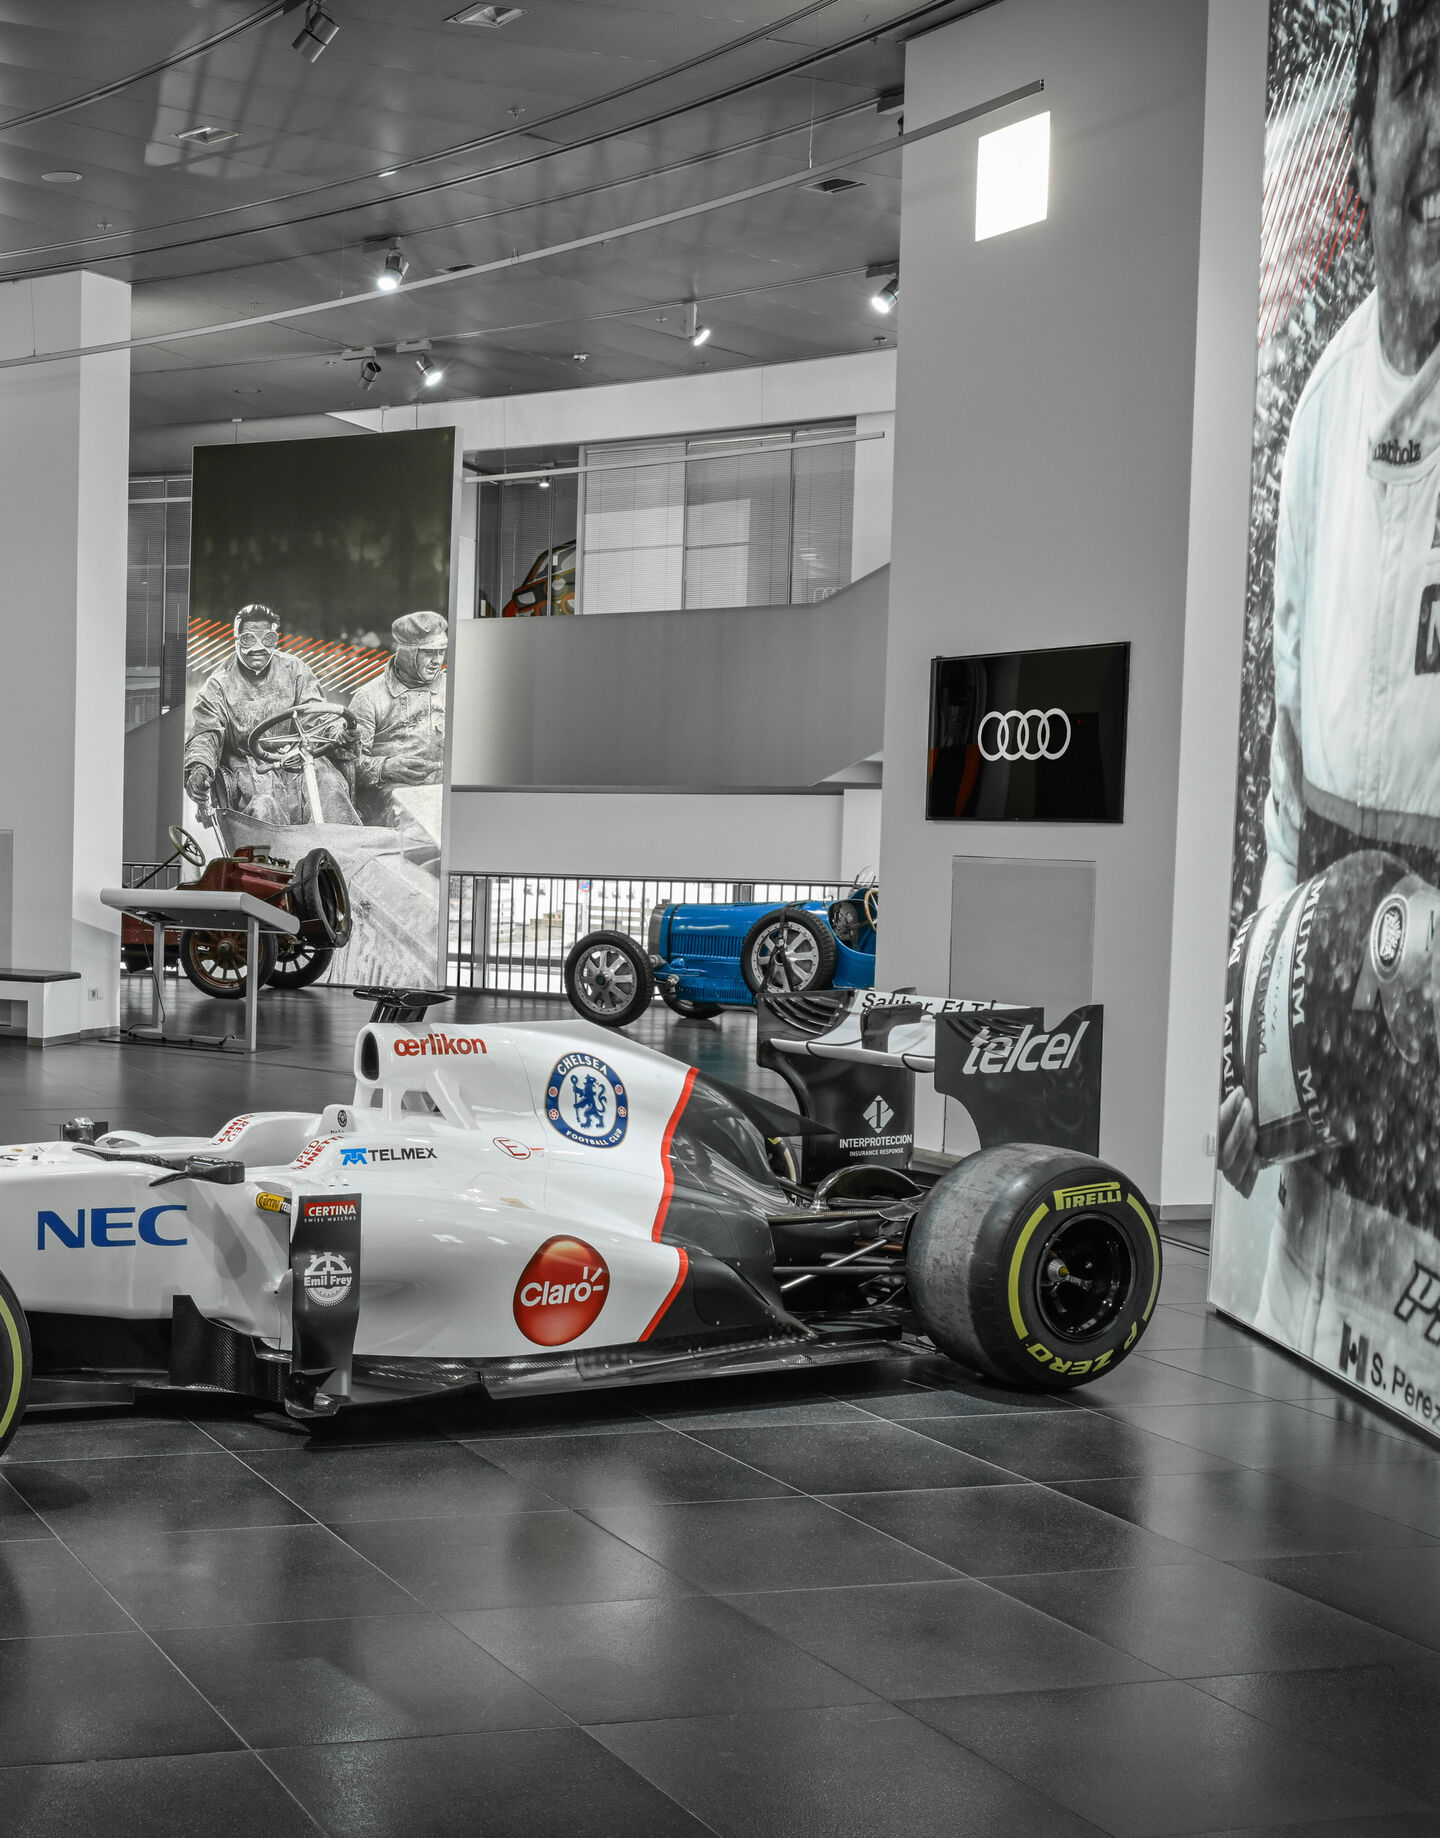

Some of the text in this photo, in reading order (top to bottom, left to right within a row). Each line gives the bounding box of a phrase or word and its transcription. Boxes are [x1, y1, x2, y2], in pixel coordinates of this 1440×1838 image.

[1292, 877, 1327, 1028] MUMM
[962, 1020, 1090, 1075] telcel
[557, 1054, 608, 1075] CHELSEA
[1297, 1065, 1338, 1146] MUM
[566, 1128, 622, 1146] FOOTBALL CLUB
[839, 1134, 913, 1149] INTERPROTECCION
[849, 1147, 904, 1157] INSURANCE RESPONSE
[368, 1147, 438, 1162] TELMEX
[308, 1204, 357, 1217] CERTINA
[1052, 1181, 1122, 1211] PIRELLI
[37, 1204, 188, 1250] NEC
[304, 1275, 352, 1288] Emil Frey
[520, 1274, 597, 1307] Claro
[1027, 1343, 1114, 1376] ZERO
[1370, 1352, 1386, 1391] S.
